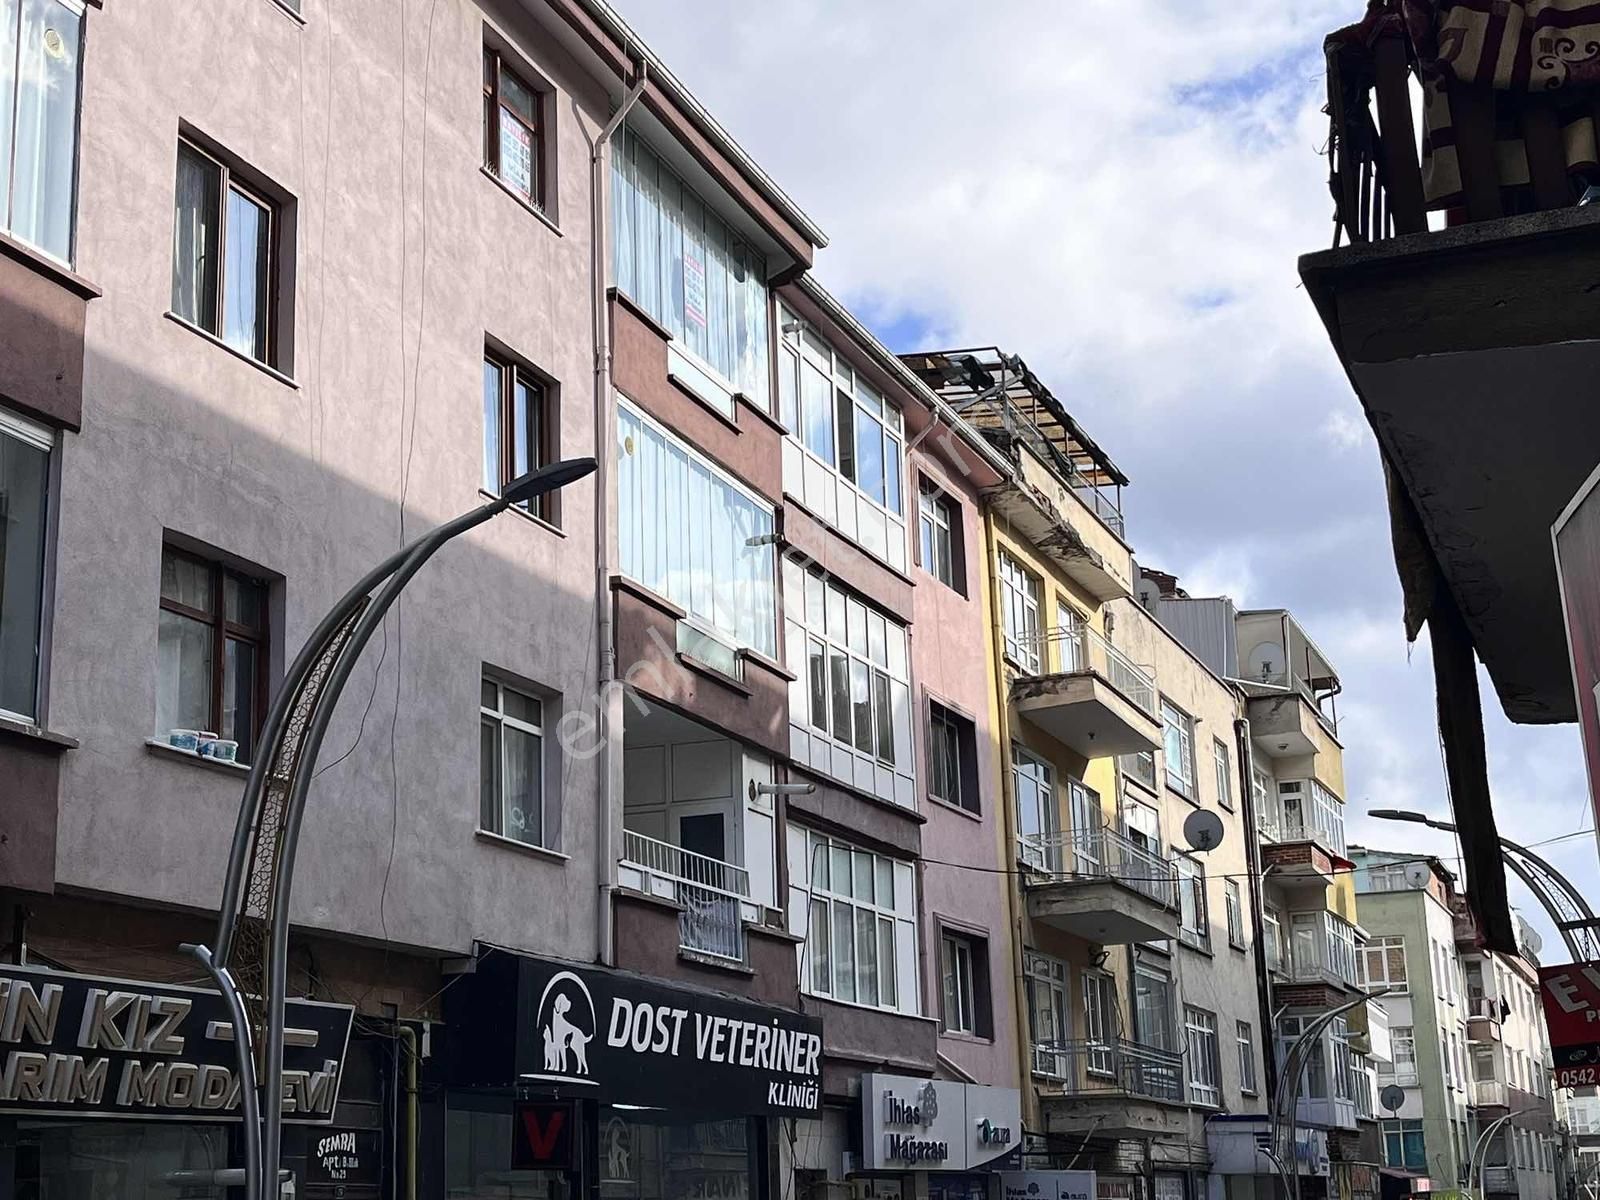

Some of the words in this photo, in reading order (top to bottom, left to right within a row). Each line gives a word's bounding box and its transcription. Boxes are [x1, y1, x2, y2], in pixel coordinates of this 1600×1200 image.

[77, 988, 192, 1055] KIZ
[607, 997, 689, 1056] DOST
[695, 1008, 822, 1076] VETERİNER
[0, 1051, 110, 1105] RIM
[767, 1079, 820, 1110] KLİNİĞİ
[1561, 1068, 1595, 1086] 0542
[884, 1090, 920, 1125] İhlas
[317, 1133, 356, 1157] SEMRA
[523, 1110, 565, 1159] V
[885, 1133, 948, 1166] Mağazası
